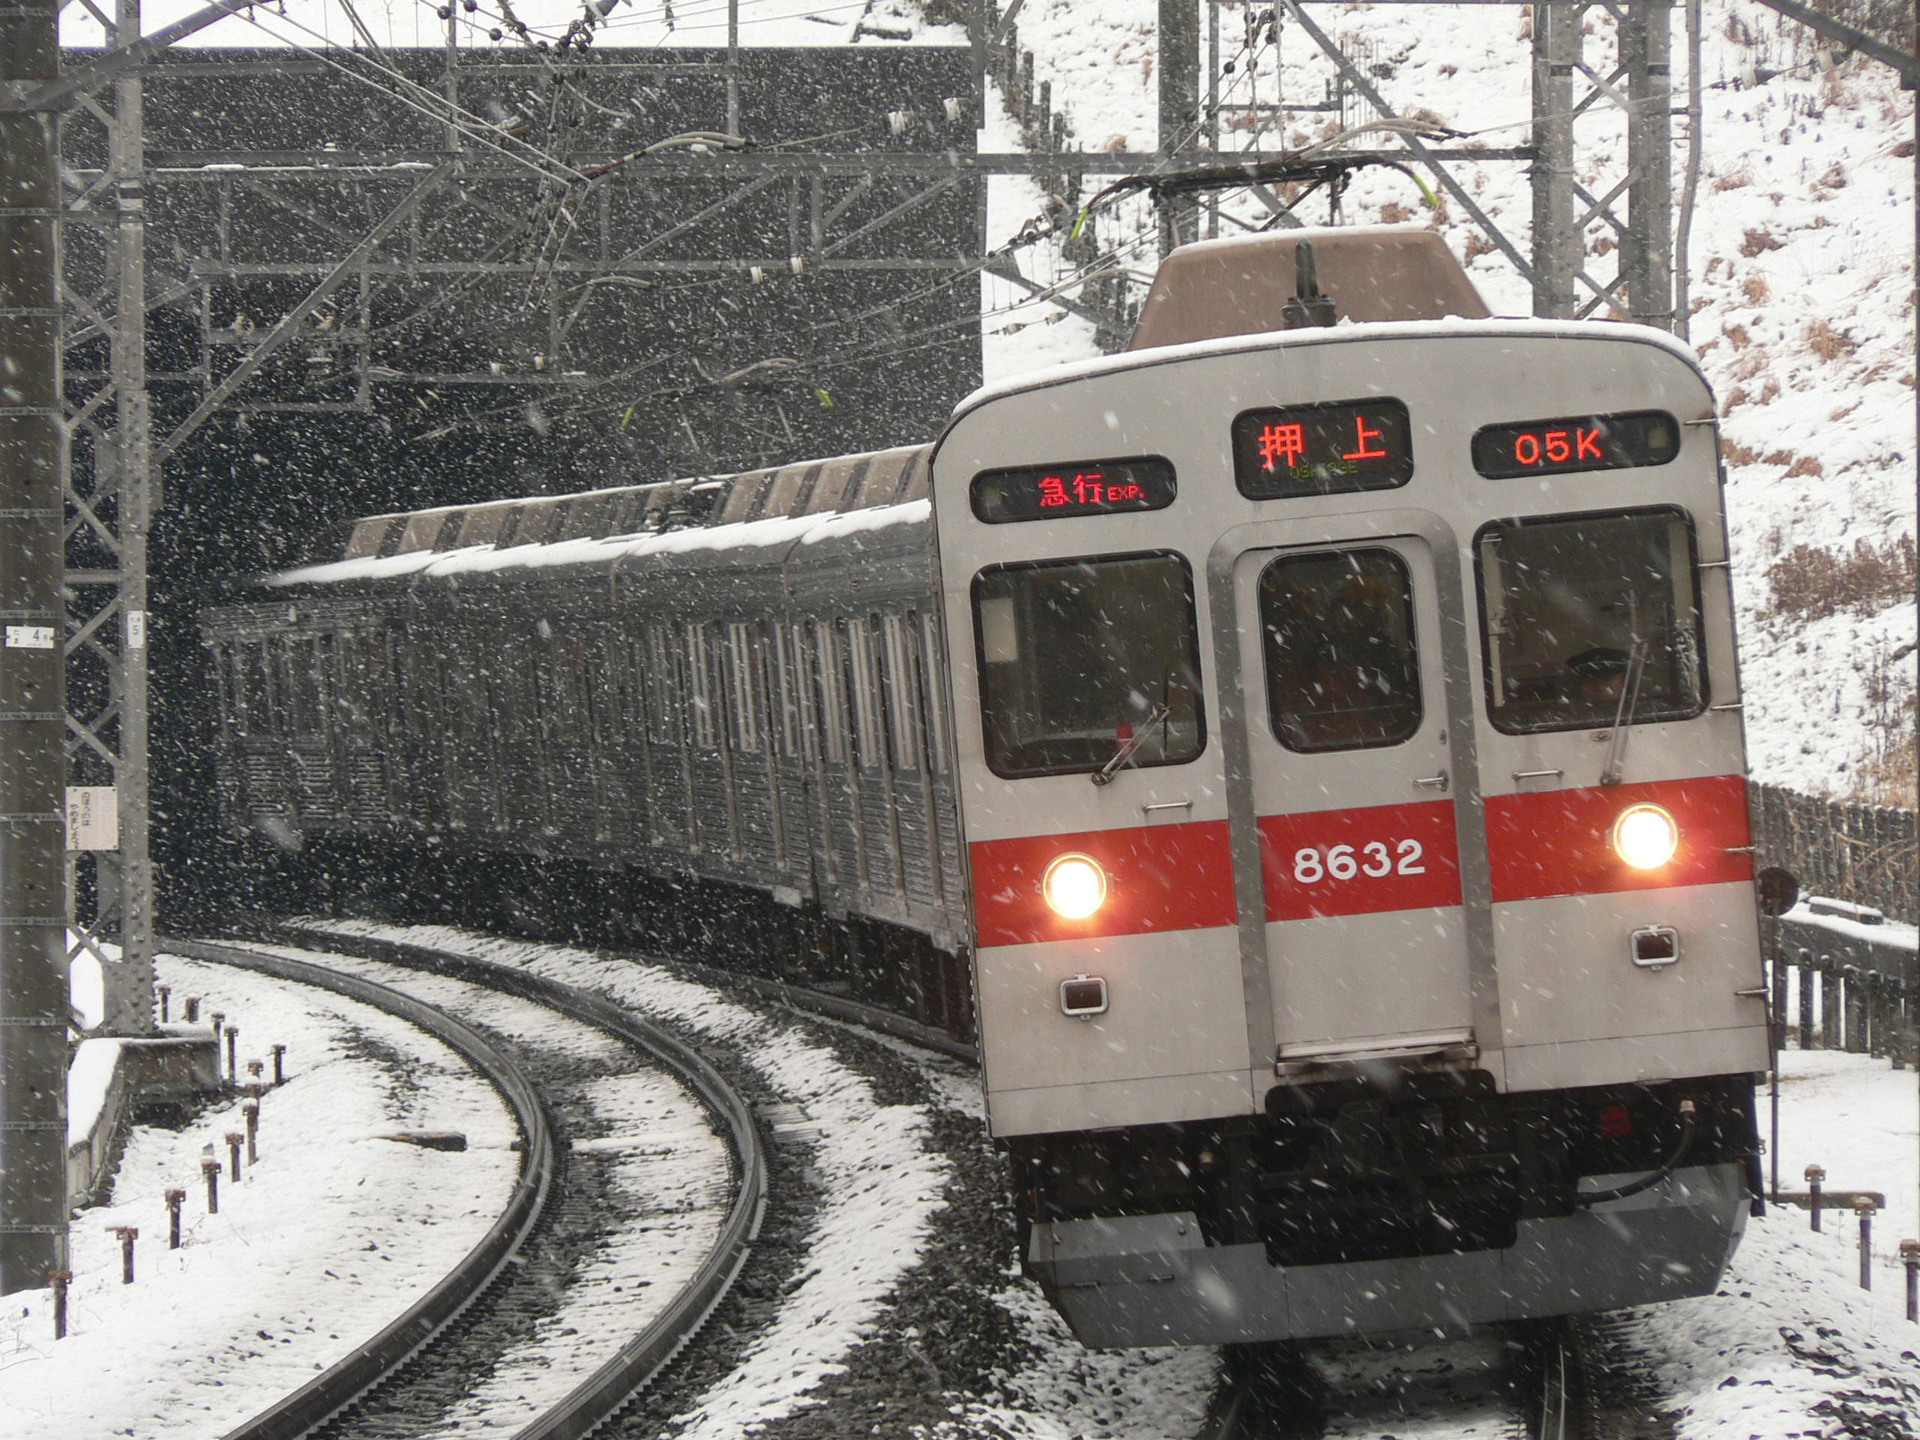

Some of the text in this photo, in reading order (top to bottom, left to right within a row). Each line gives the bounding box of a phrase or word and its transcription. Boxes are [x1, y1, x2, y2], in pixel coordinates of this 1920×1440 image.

[1258, 416, 1387, 470] 押上
[1515, 428, 1603, 465] 05K
[1038, 473, 1103, 507] 急行
[1294, 838, 1426, 884] 8632
